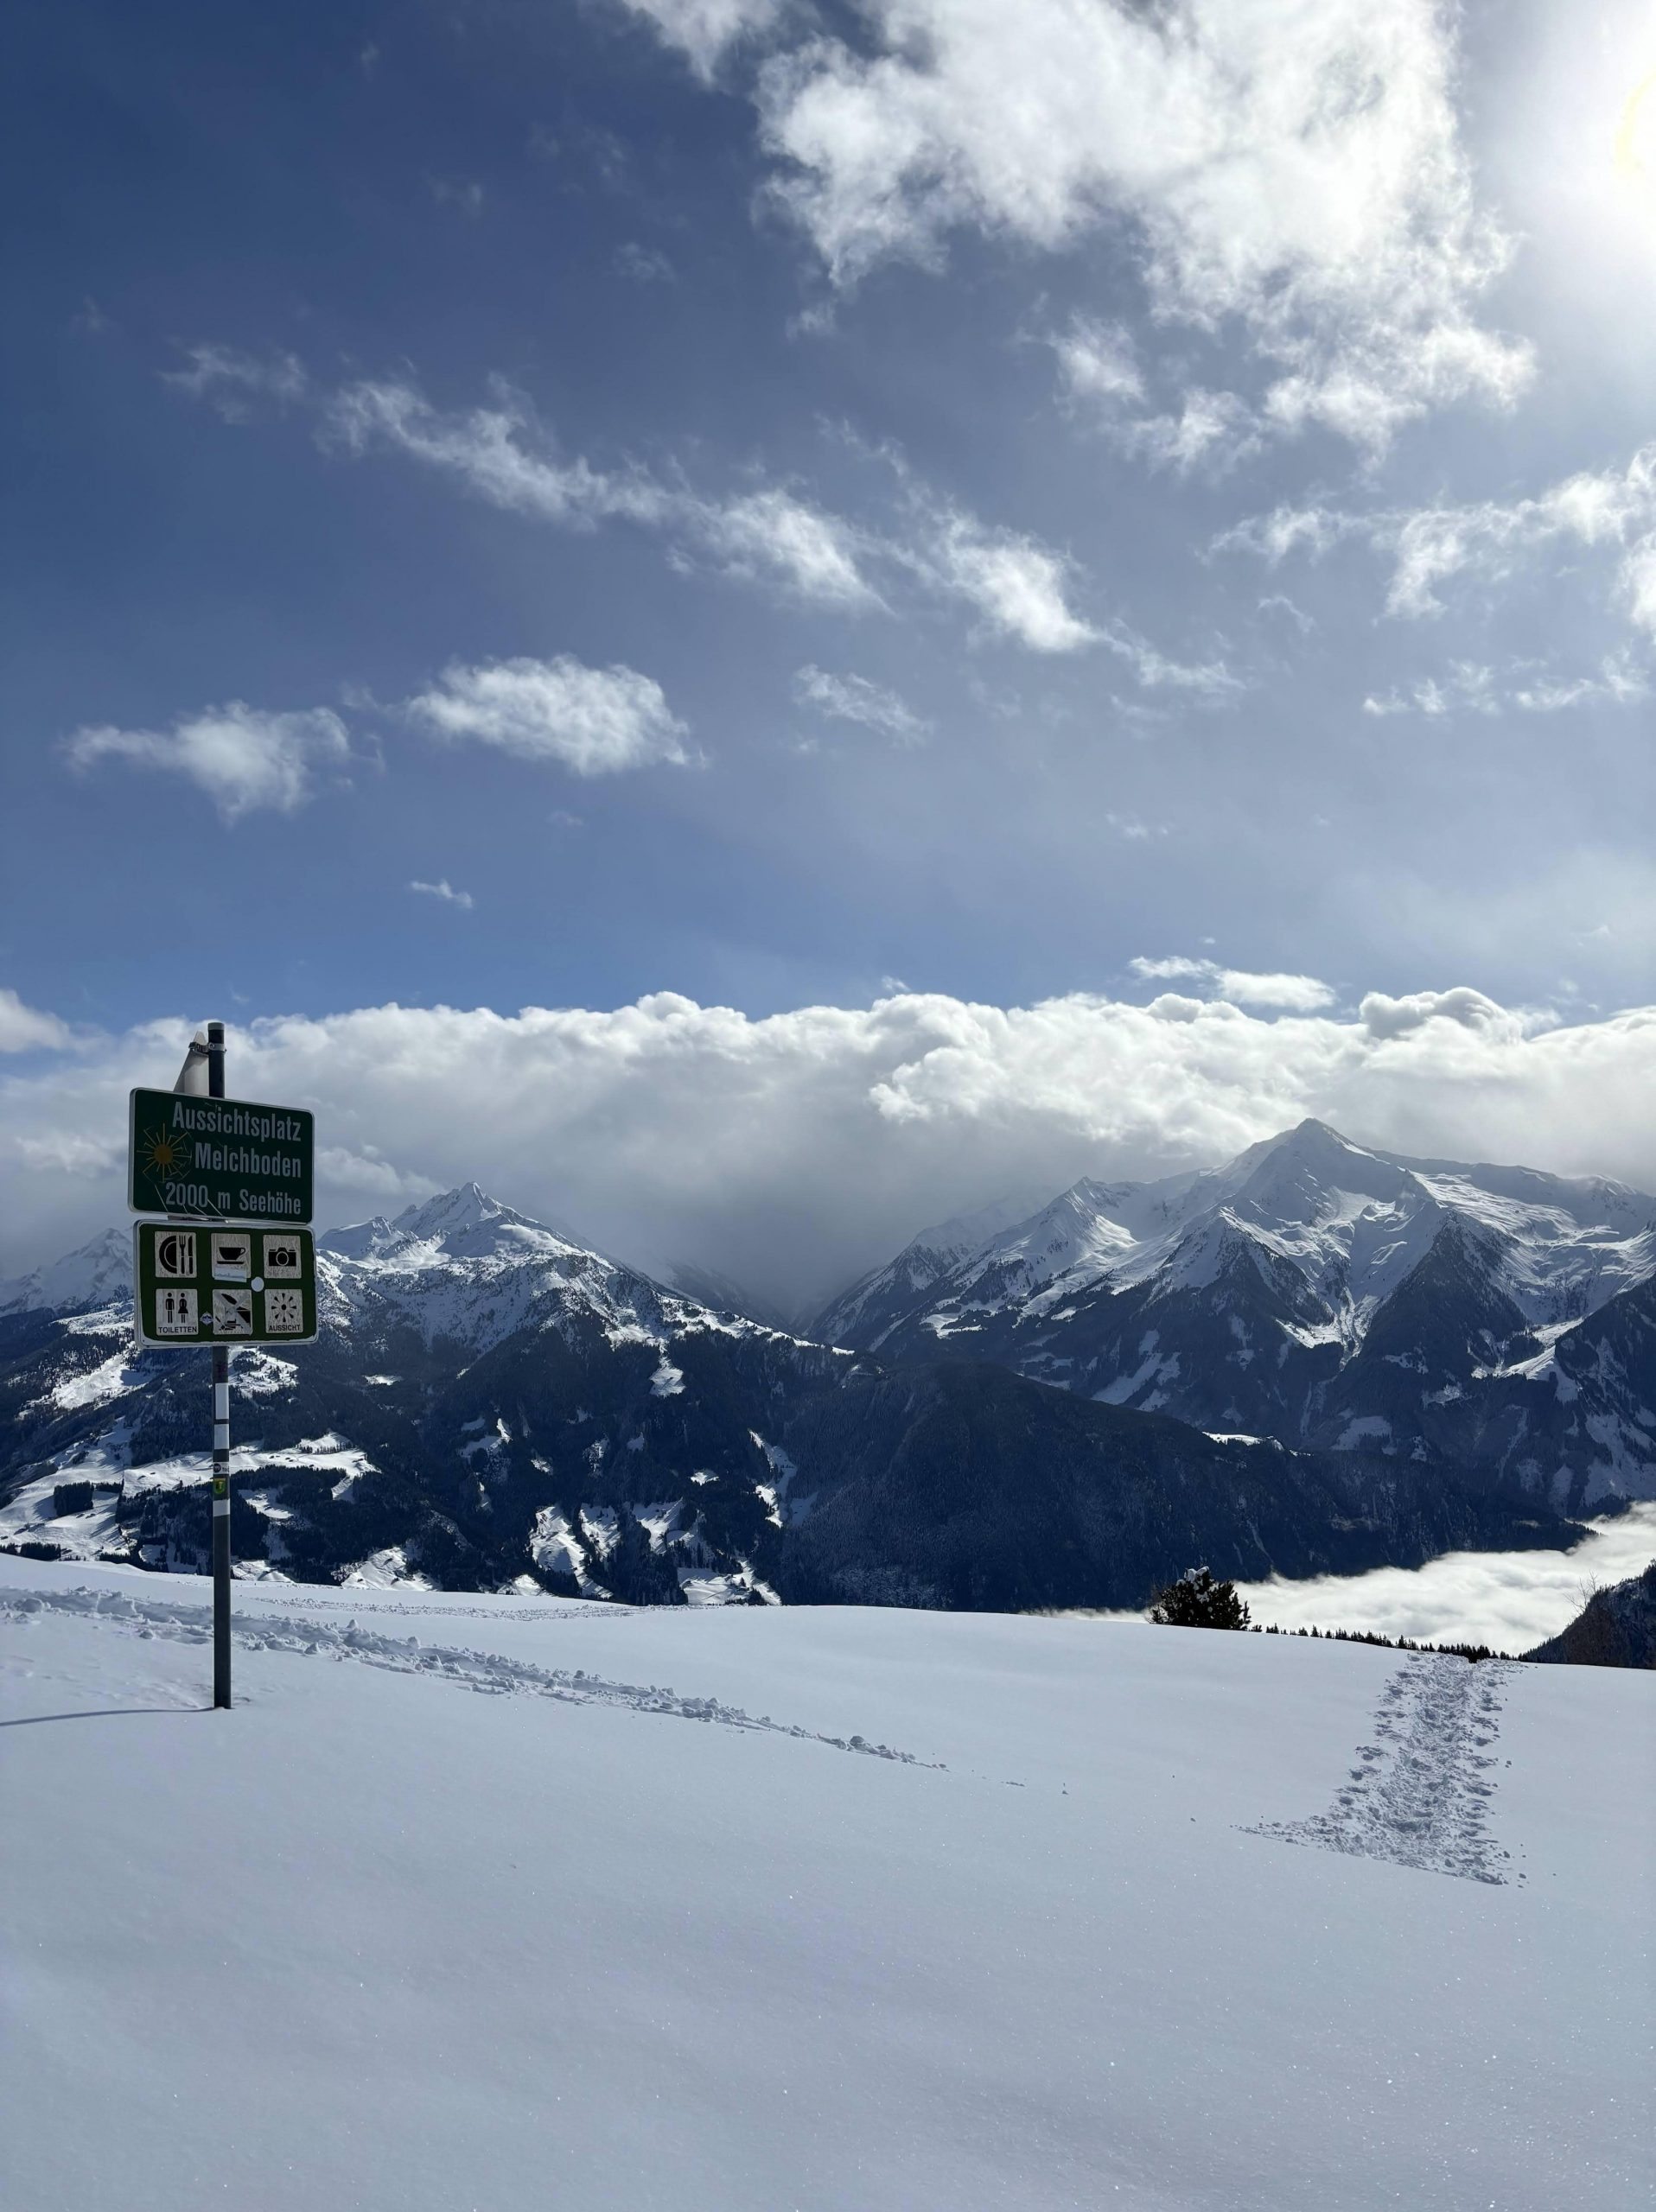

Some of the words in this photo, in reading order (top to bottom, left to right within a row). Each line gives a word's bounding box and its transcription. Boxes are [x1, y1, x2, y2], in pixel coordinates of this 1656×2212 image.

[172, 1101, 302, 1142] Aussichtsplatz
[194, 1141, 302, 1178] Melchboden
[165, 1181, 208, 1208] 2000
[217, 1191, 231, 1209] m
[239, 1188, 302, 1215] Seehöhe
[158, 1325, 197, 1334] TOILETTEN
